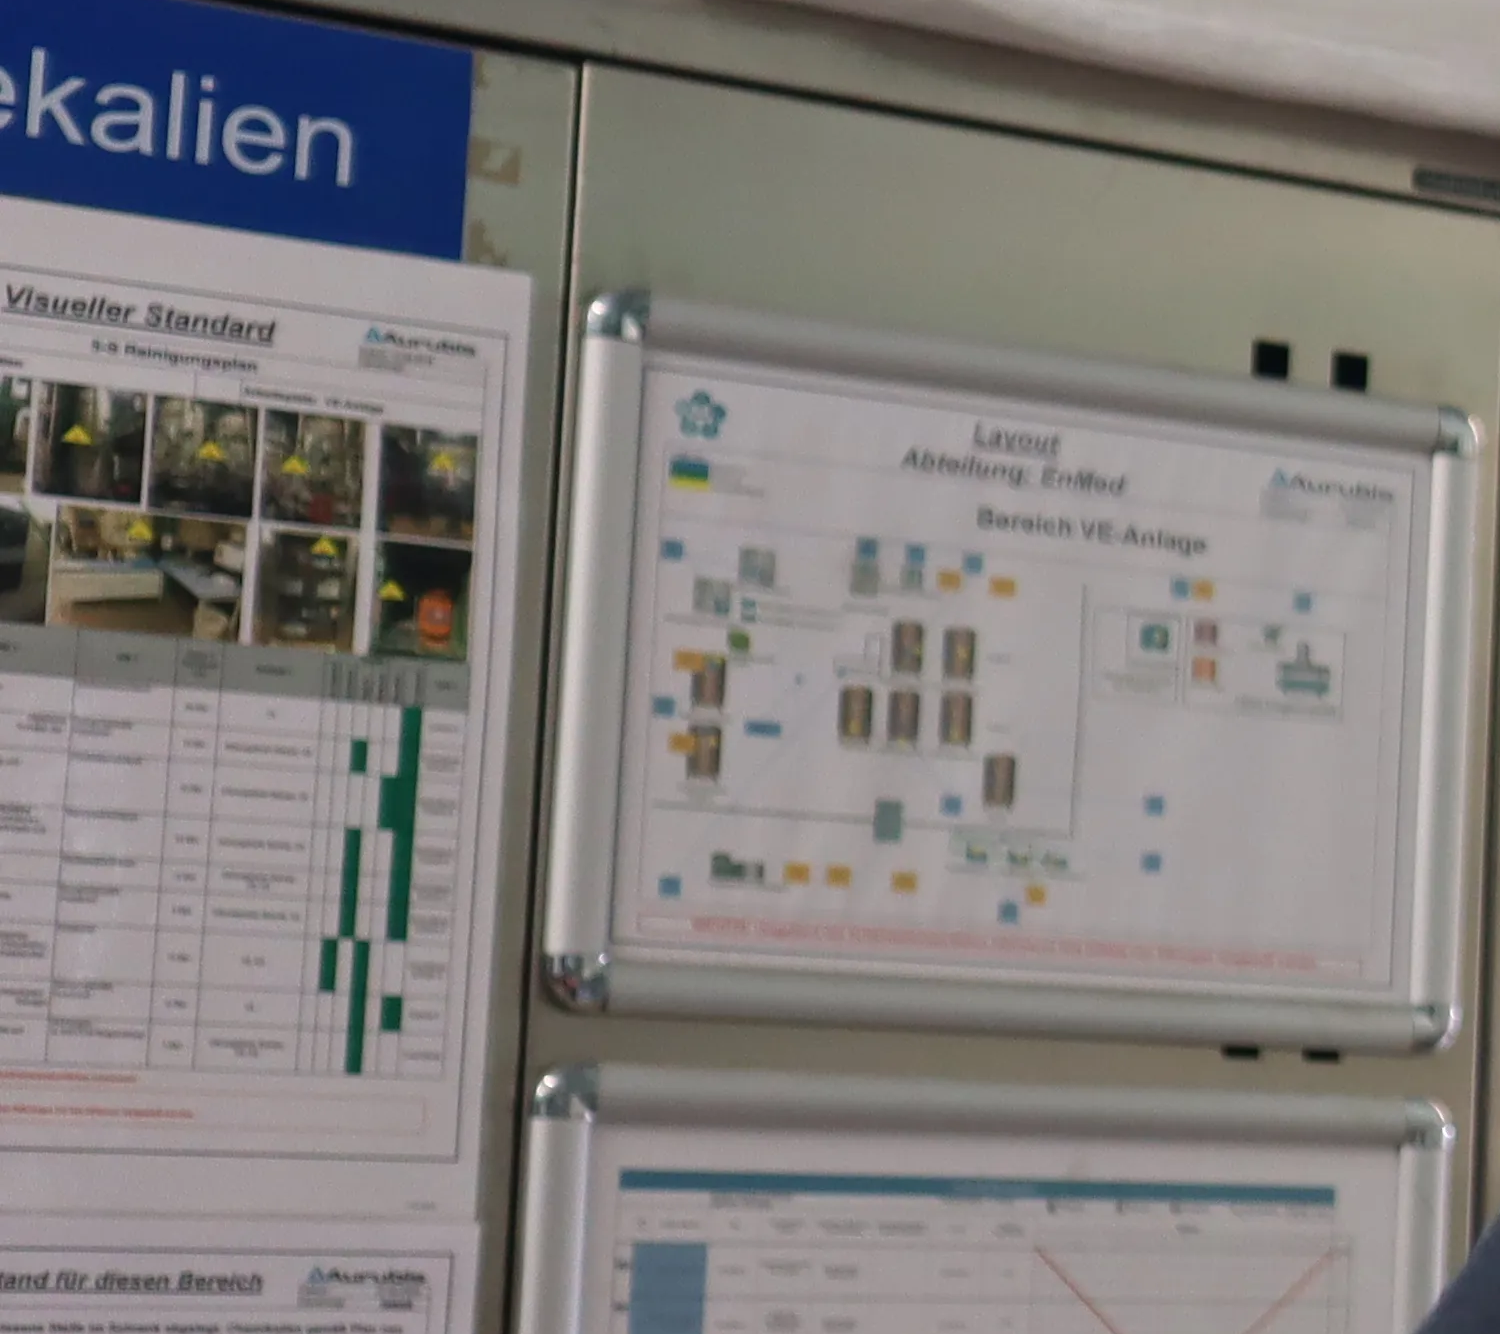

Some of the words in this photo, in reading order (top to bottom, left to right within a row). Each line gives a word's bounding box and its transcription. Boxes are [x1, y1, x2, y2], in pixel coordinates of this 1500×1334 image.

[0, 46, 354, 187] kalien
[3, 284, 136, 324] Visueller
[145, 302, 277, 343] Standard
[973, 422, 1061, 456] Layout
[976, 504, 1072, 539] Bereich
[56, 1268, 88, 1291] für
[95, 1269, 170, 1292] diesen
[176, 1270, 264, 1293] Bereich
